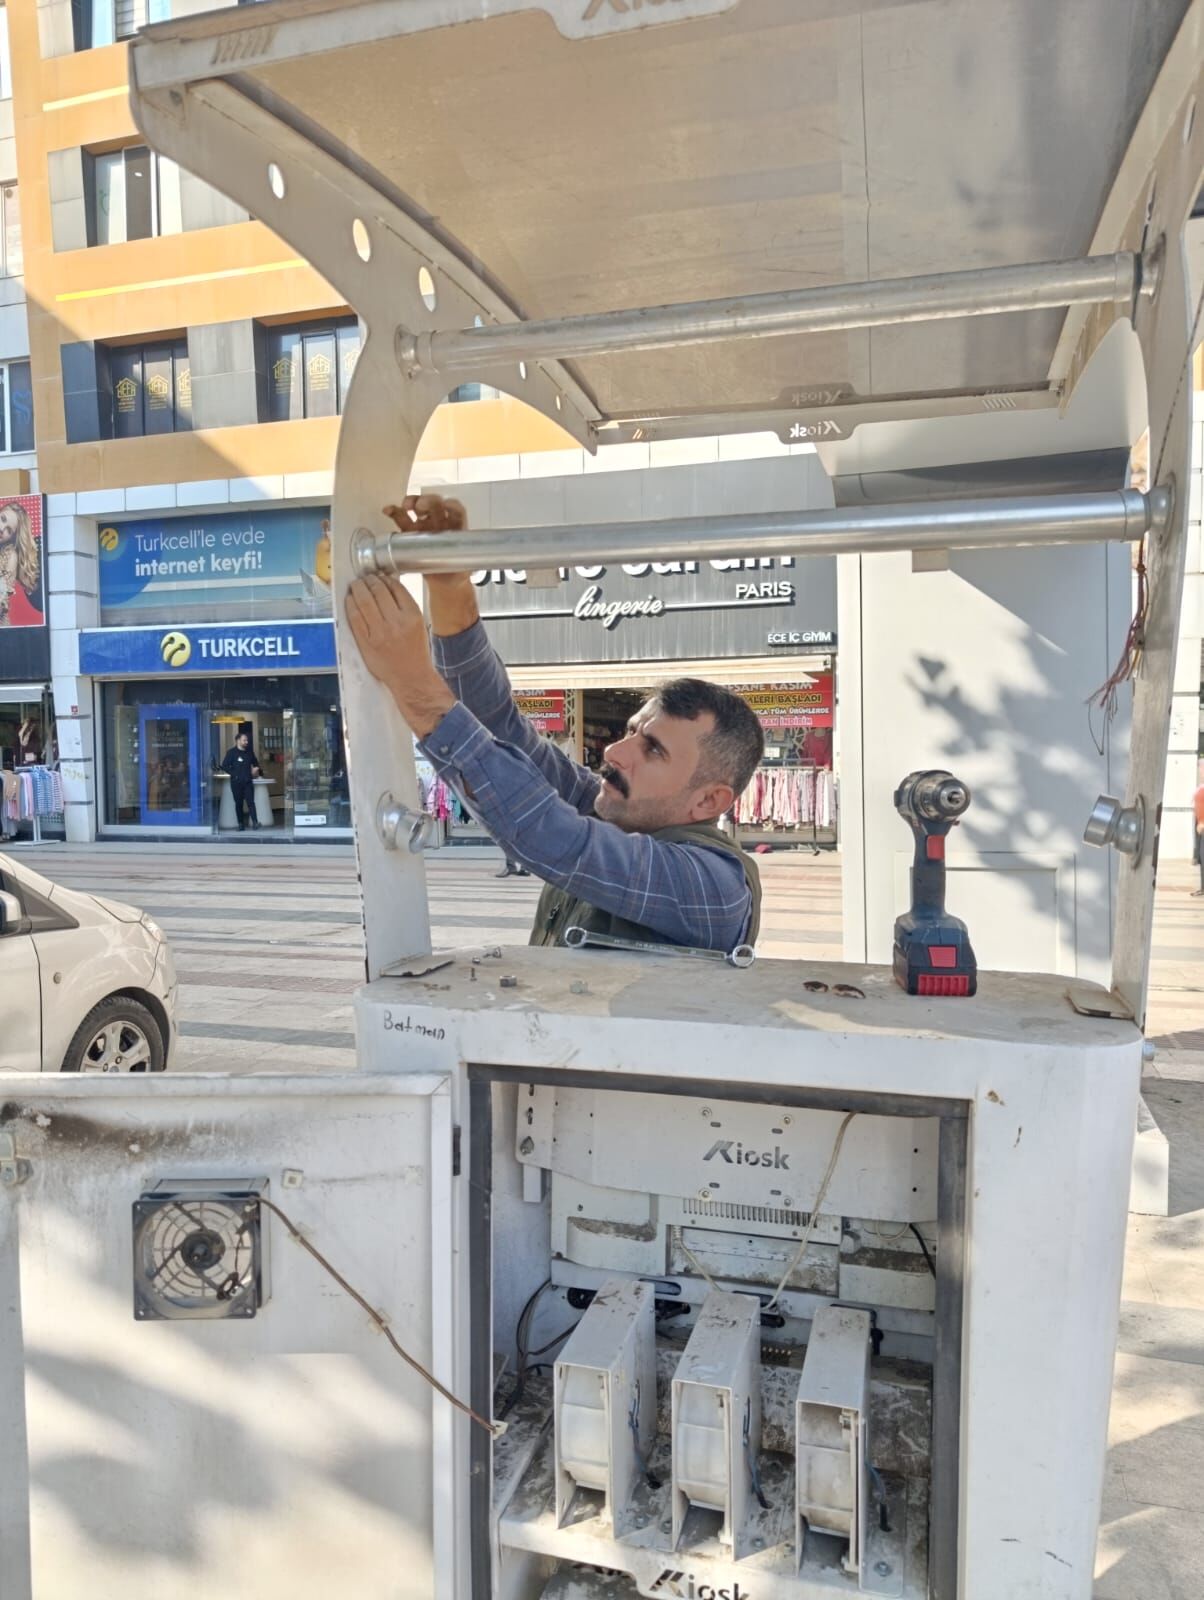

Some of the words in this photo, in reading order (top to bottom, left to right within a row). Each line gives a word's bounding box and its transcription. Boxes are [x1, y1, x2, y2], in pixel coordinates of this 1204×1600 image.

[134, 528, 216, 553] Turkcell'le
[222, 525, 265, 546] evde
[135, 557, 206, 577] internet
[210, 550, 263, 575] keyfi!
[735, 581, 793, 599] PARIS
[573, 585, 664, 628] lingerie
[197, 636, 301, 658] TURKCELL
[767, 633, 787, 643] ECE
[702, 1140, 790, 1170] Kiosk
[650, 1568, 751, 1600] Kiosk
